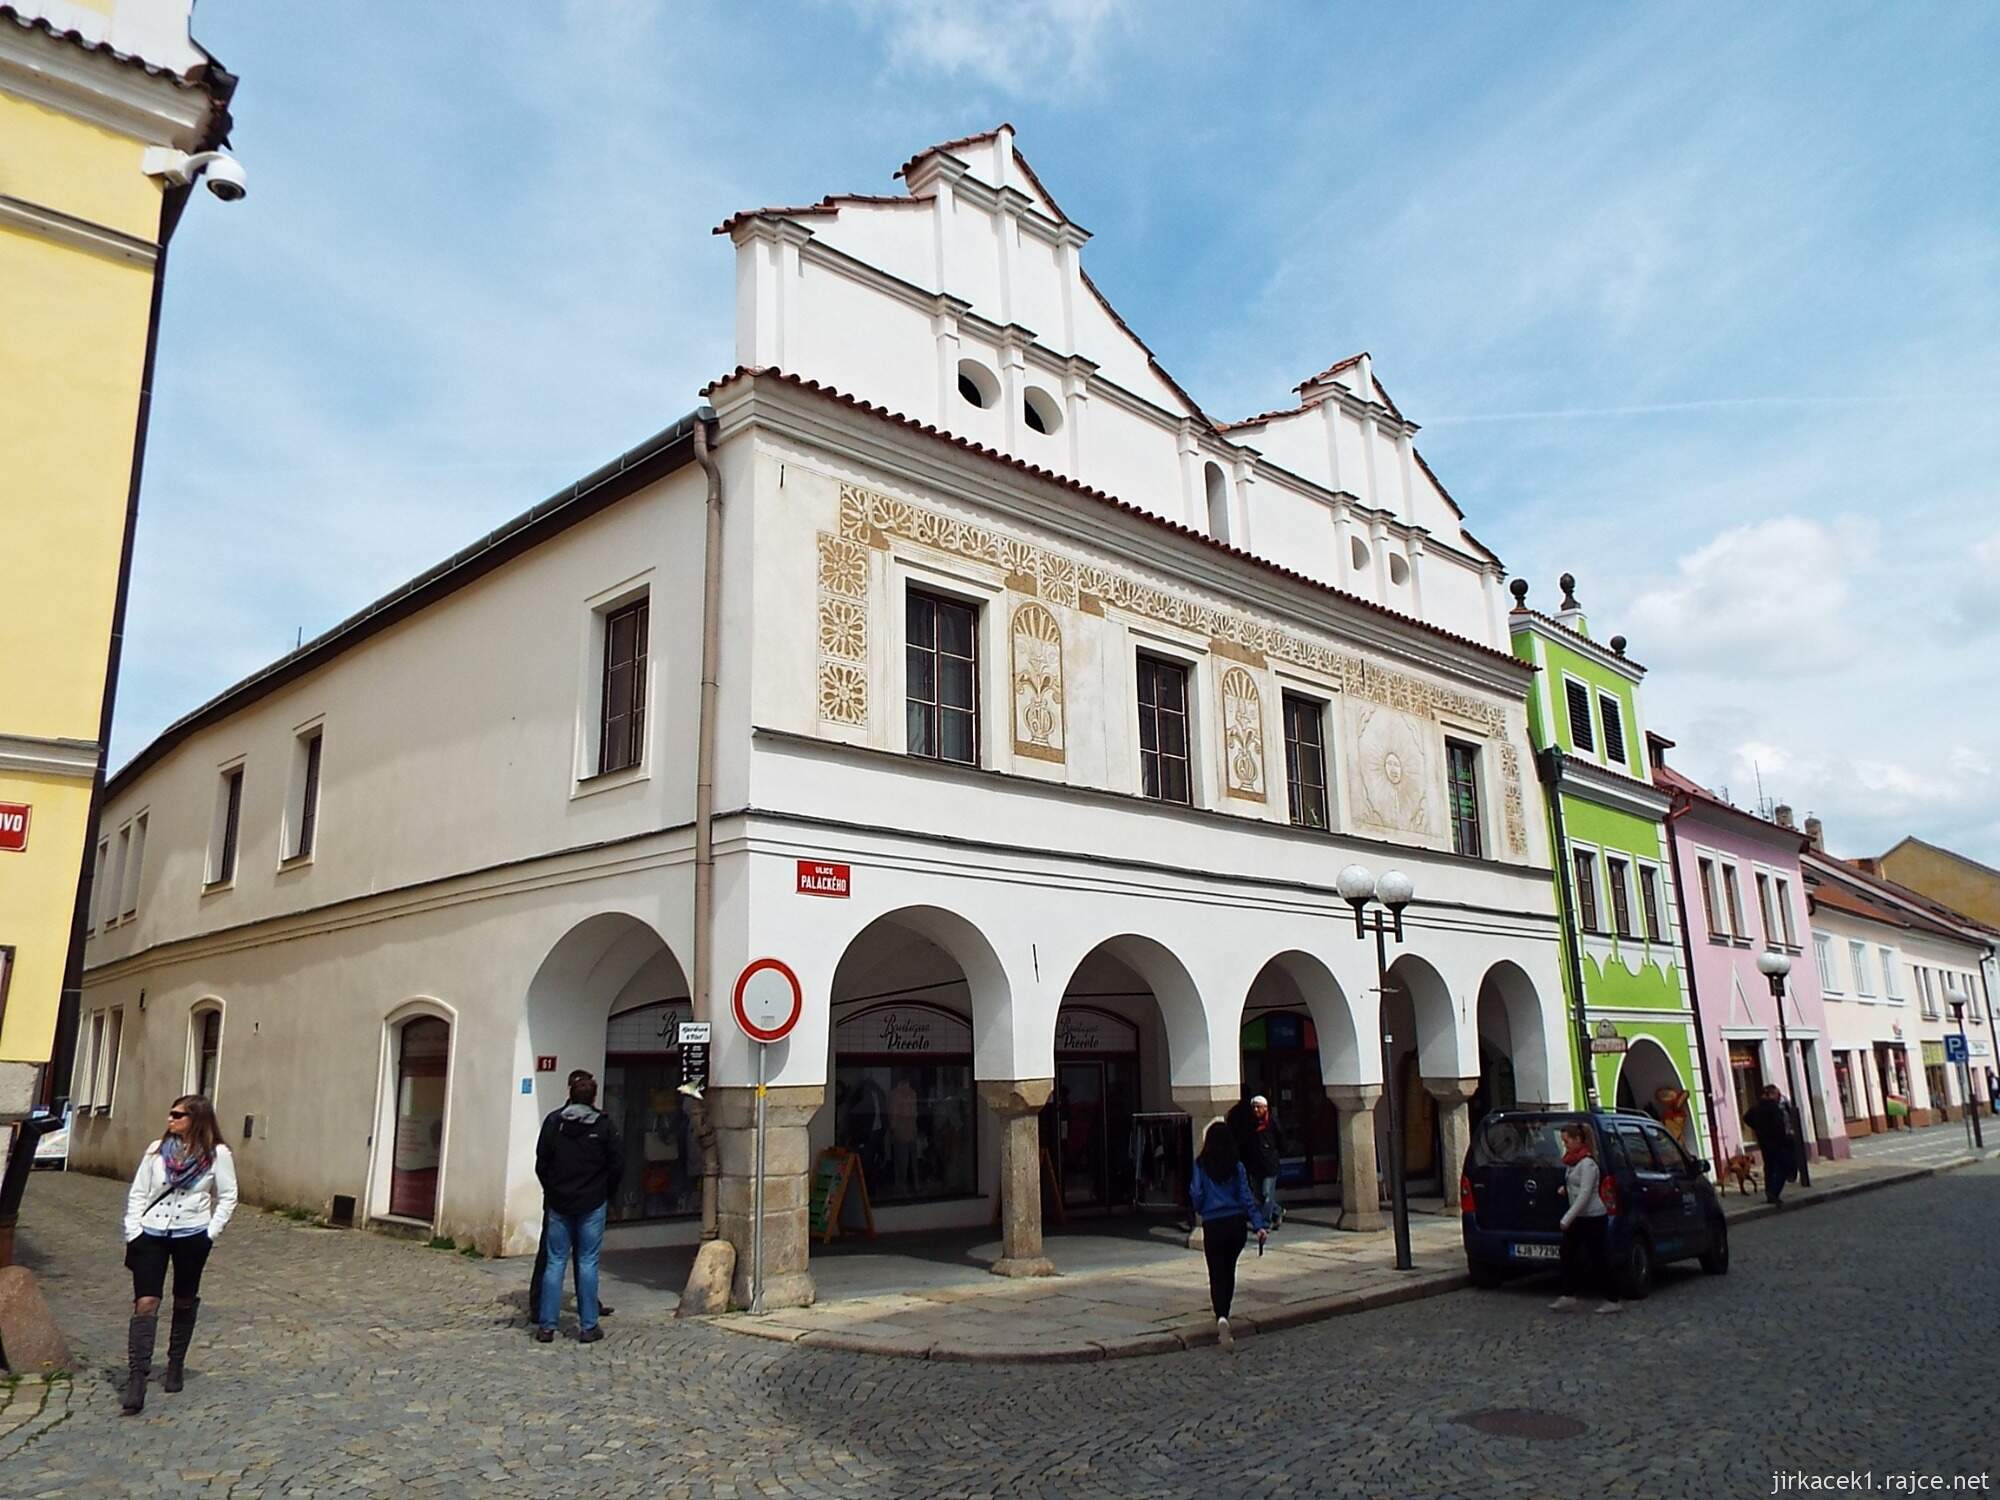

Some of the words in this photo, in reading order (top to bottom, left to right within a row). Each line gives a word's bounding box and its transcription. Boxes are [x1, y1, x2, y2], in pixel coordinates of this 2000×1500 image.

[801, 875, 847, 892] PALACKÉHO
[887, 1033, 930, 1050] Piccolo
[1949, 1037, 1962, 1054] P
[542, 1058, 552, 1070] 61
